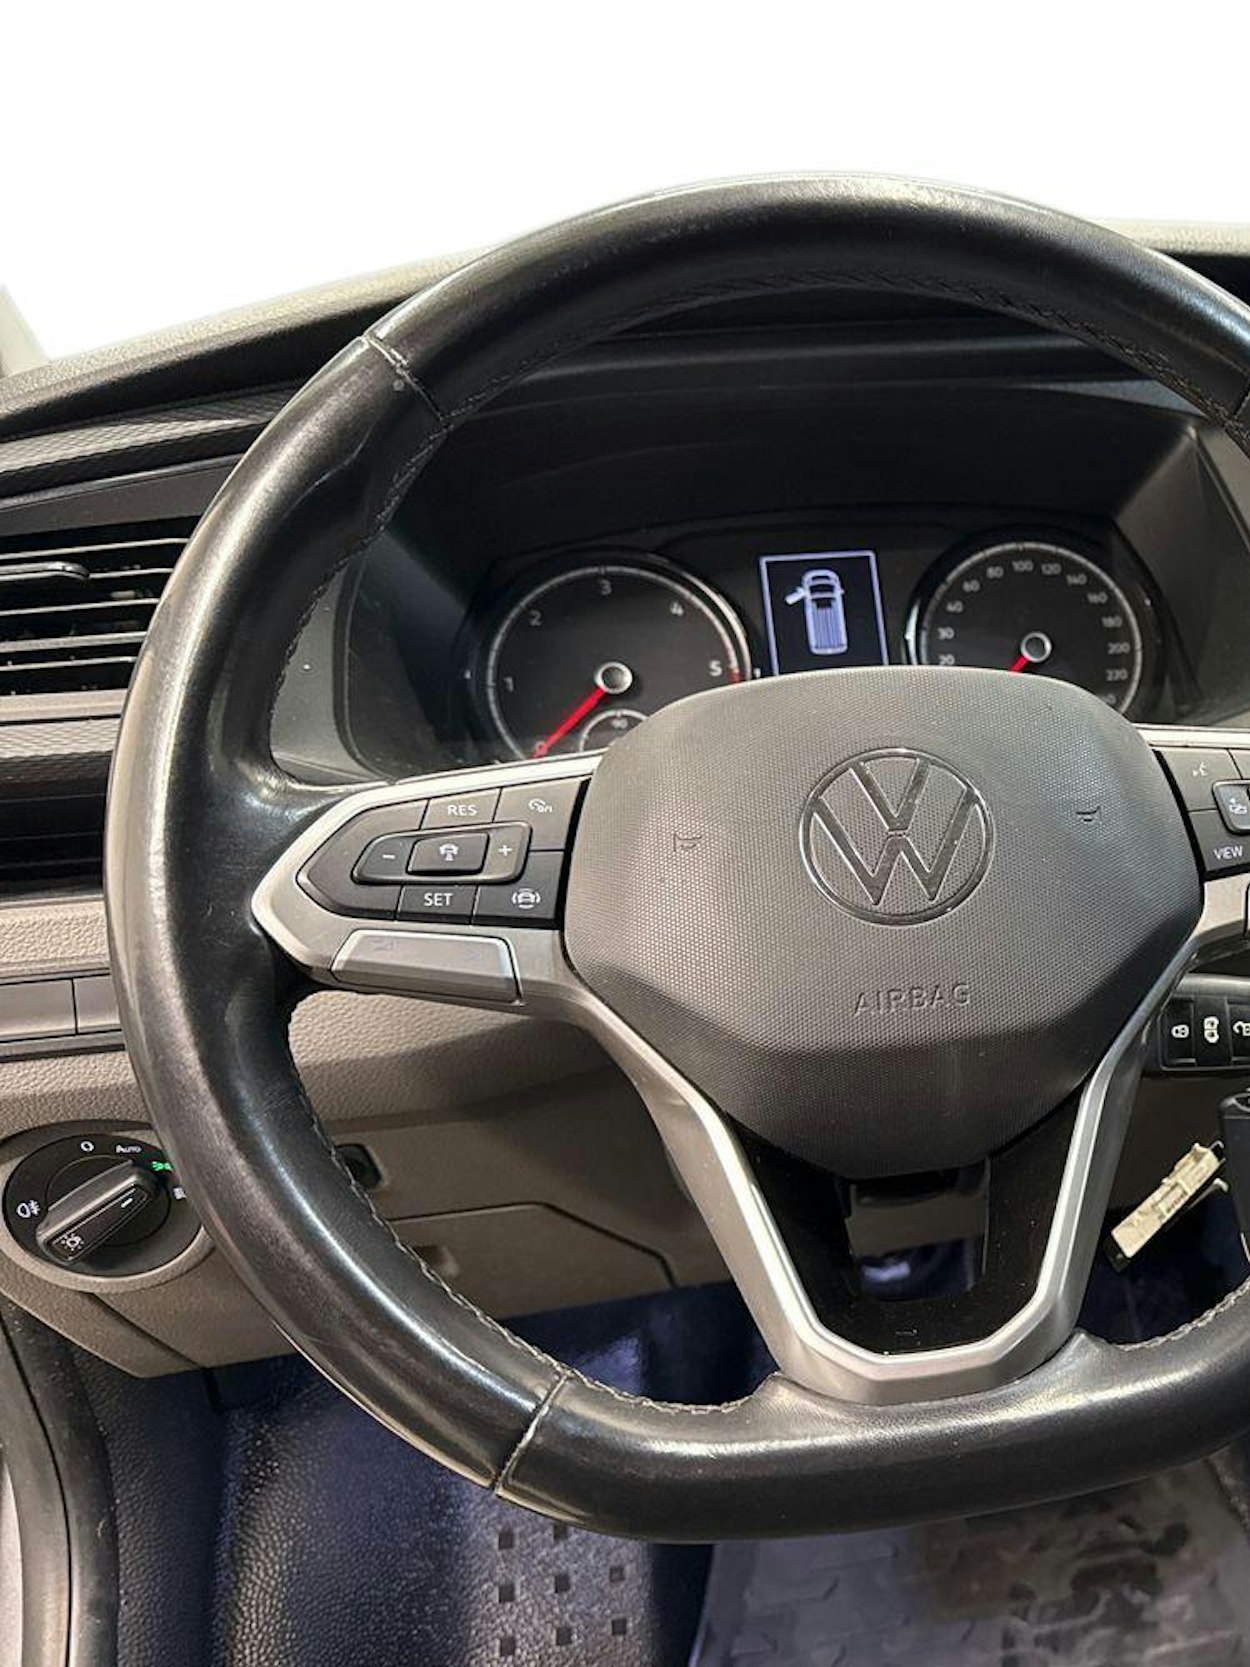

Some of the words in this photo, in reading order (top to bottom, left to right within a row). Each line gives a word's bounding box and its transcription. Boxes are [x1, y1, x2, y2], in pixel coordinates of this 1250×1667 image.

[986, 565, 1004, 580] 80
[1012, 561, 1033, 573] 100
[1041, 563, 1062, 576] 120
[962, 579, 981, 593] 60
[1066, 573, 1087, 586] 140
[600, 579, 612, 596] 3
[1087, 592, 1107, 605] 160
[670, 601, 684, 617] 4
[946, 600, 964, 614] 40
[530, 609, 542, 627] 2
[1102, 616, 1122, 629] 180
[938, 626, 955, 640] 30
[1108, 642, 1130, 655] 200
[709, 660, 723, 677] 5
[1106, 669, 1128, 682] 220
[504, 677, 515, 693] 1
[447, 804, 478, 817] RES
[1213, 845, 1244, 860] VIEW
[423, 893, 452, 907] SET
[853, 983, 971, 1016] AIRBAG
